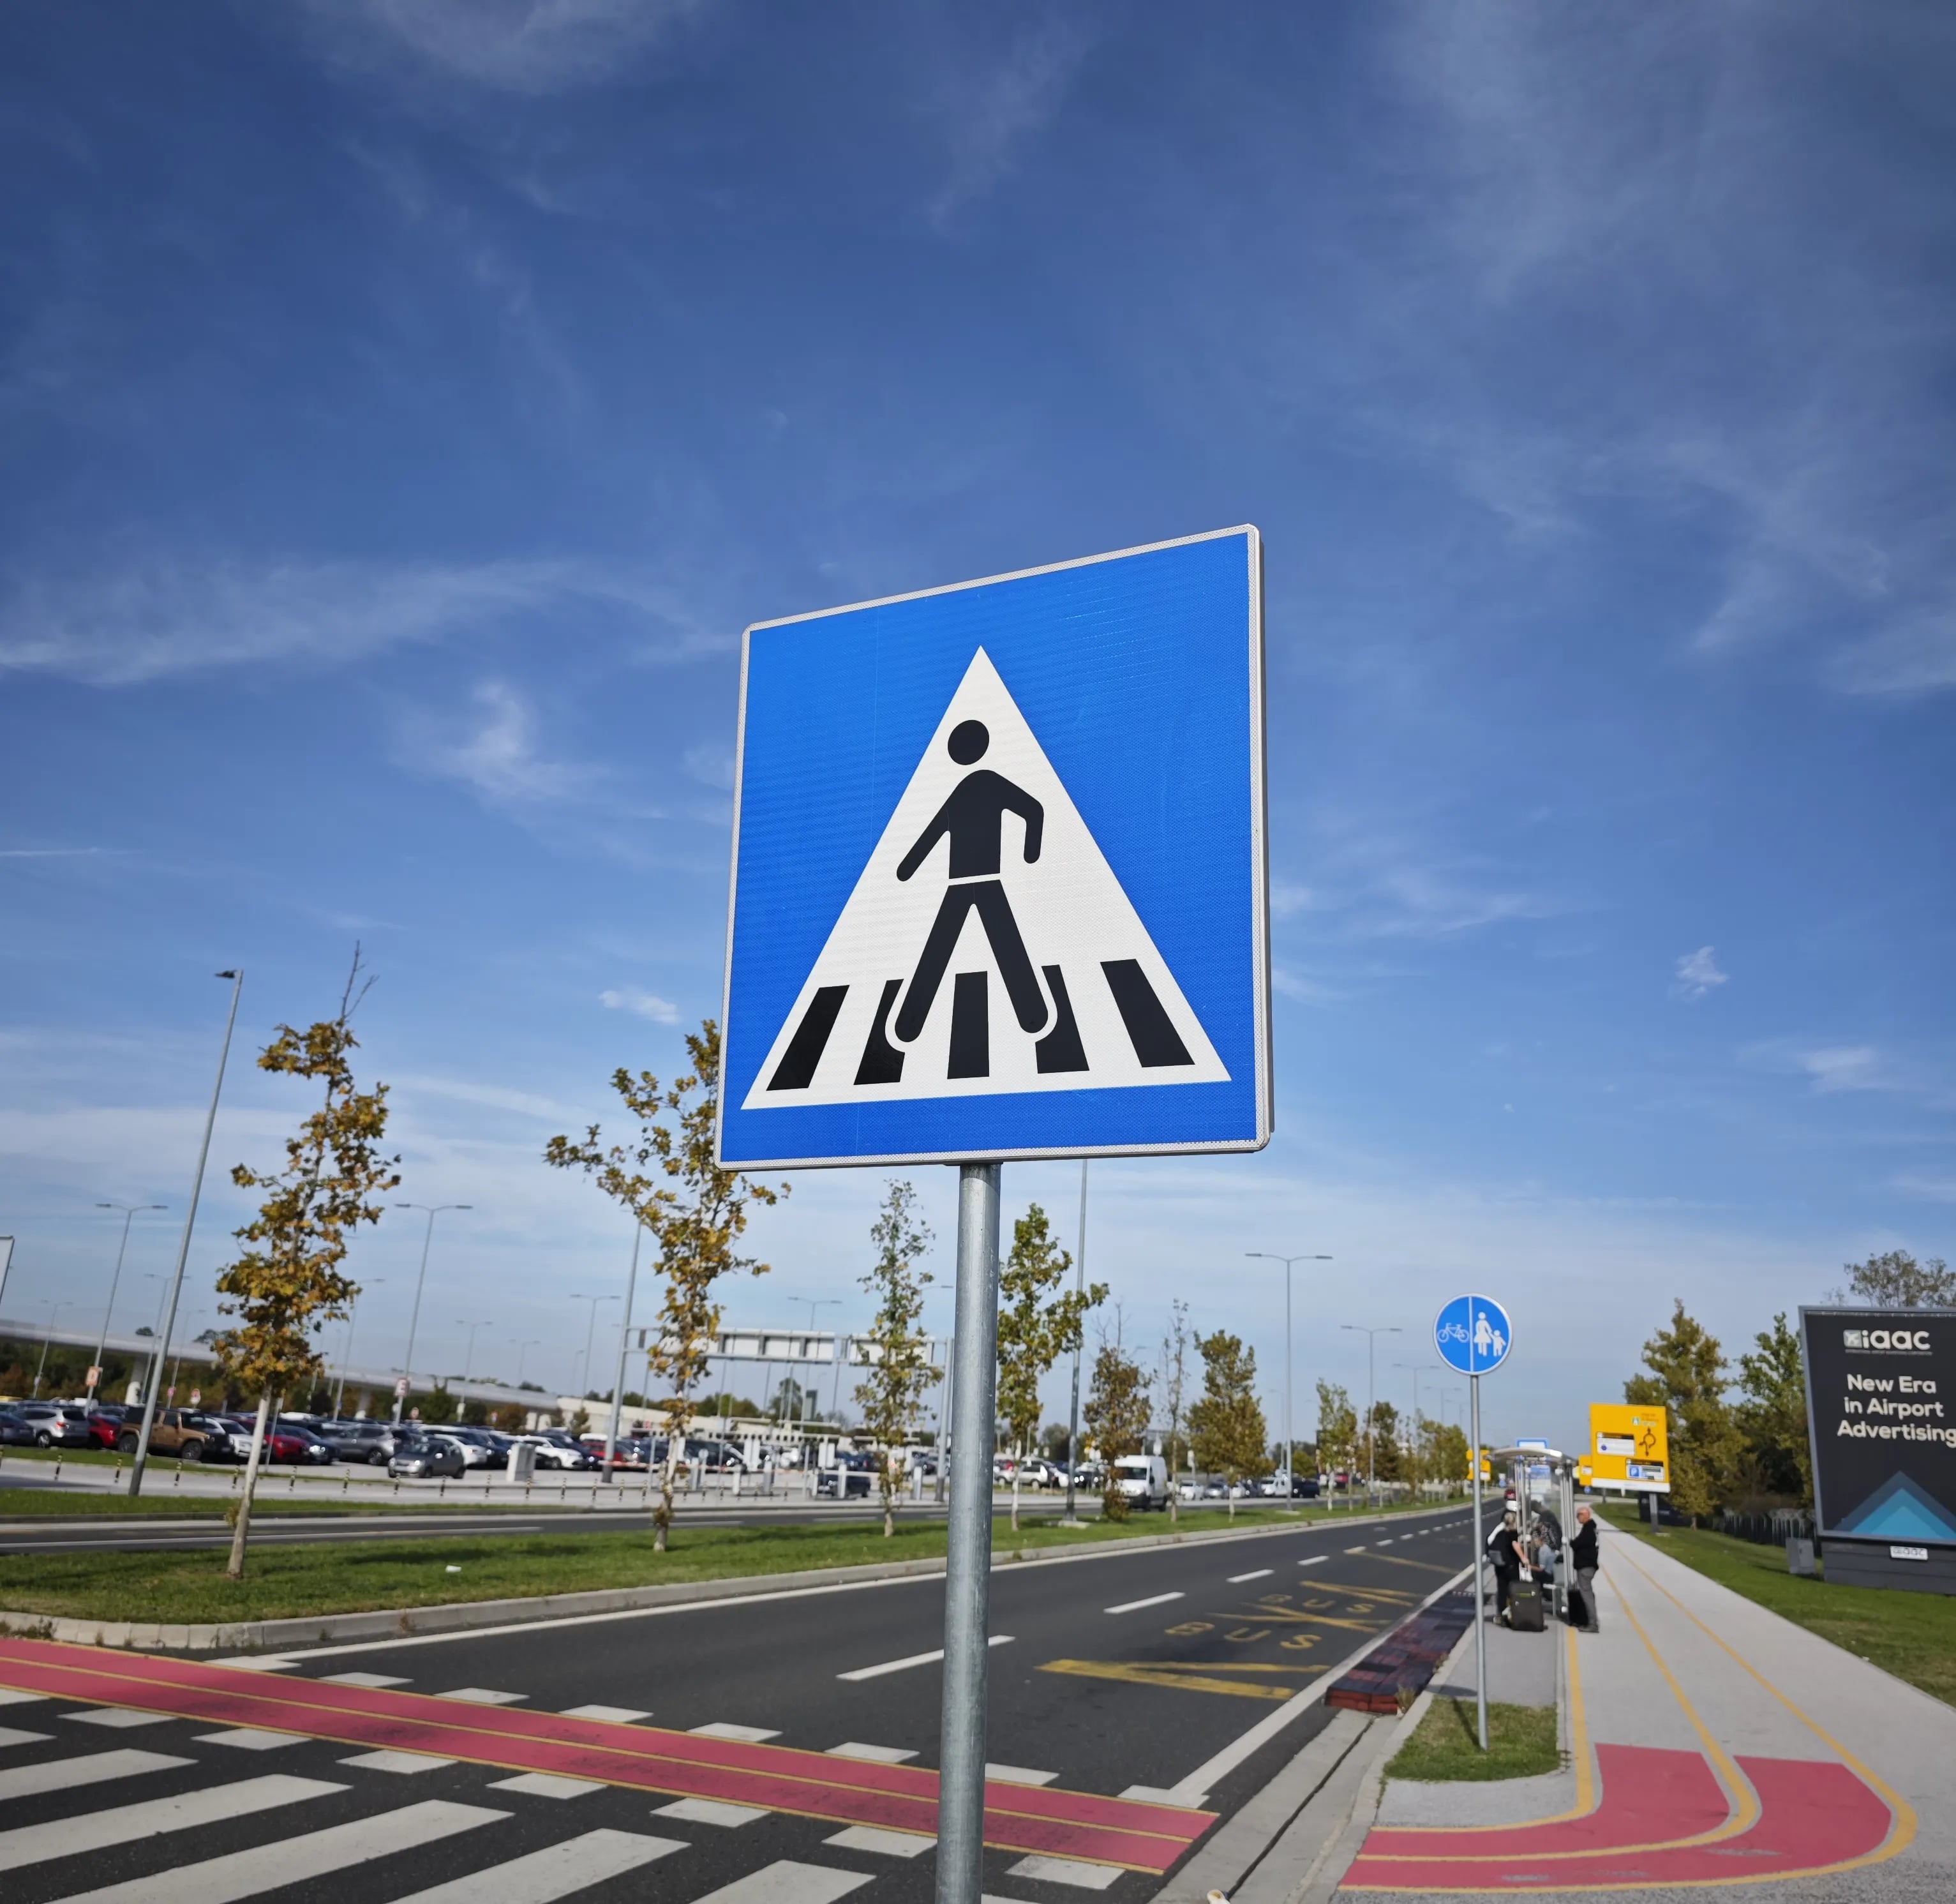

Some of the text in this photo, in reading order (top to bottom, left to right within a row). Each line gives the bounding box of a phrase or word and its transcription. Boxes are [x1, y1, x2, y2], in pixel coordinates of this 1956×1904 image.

[1862, 1329, 1930, 1351] iaac
[1848, 1374, 1937, 1394] New Era
[1844, 1397, 1945, 1420] in Airport
[1837, 1420, 1956, 1448] Advertising
[1165, 1621, 1322, 1650] BUS
